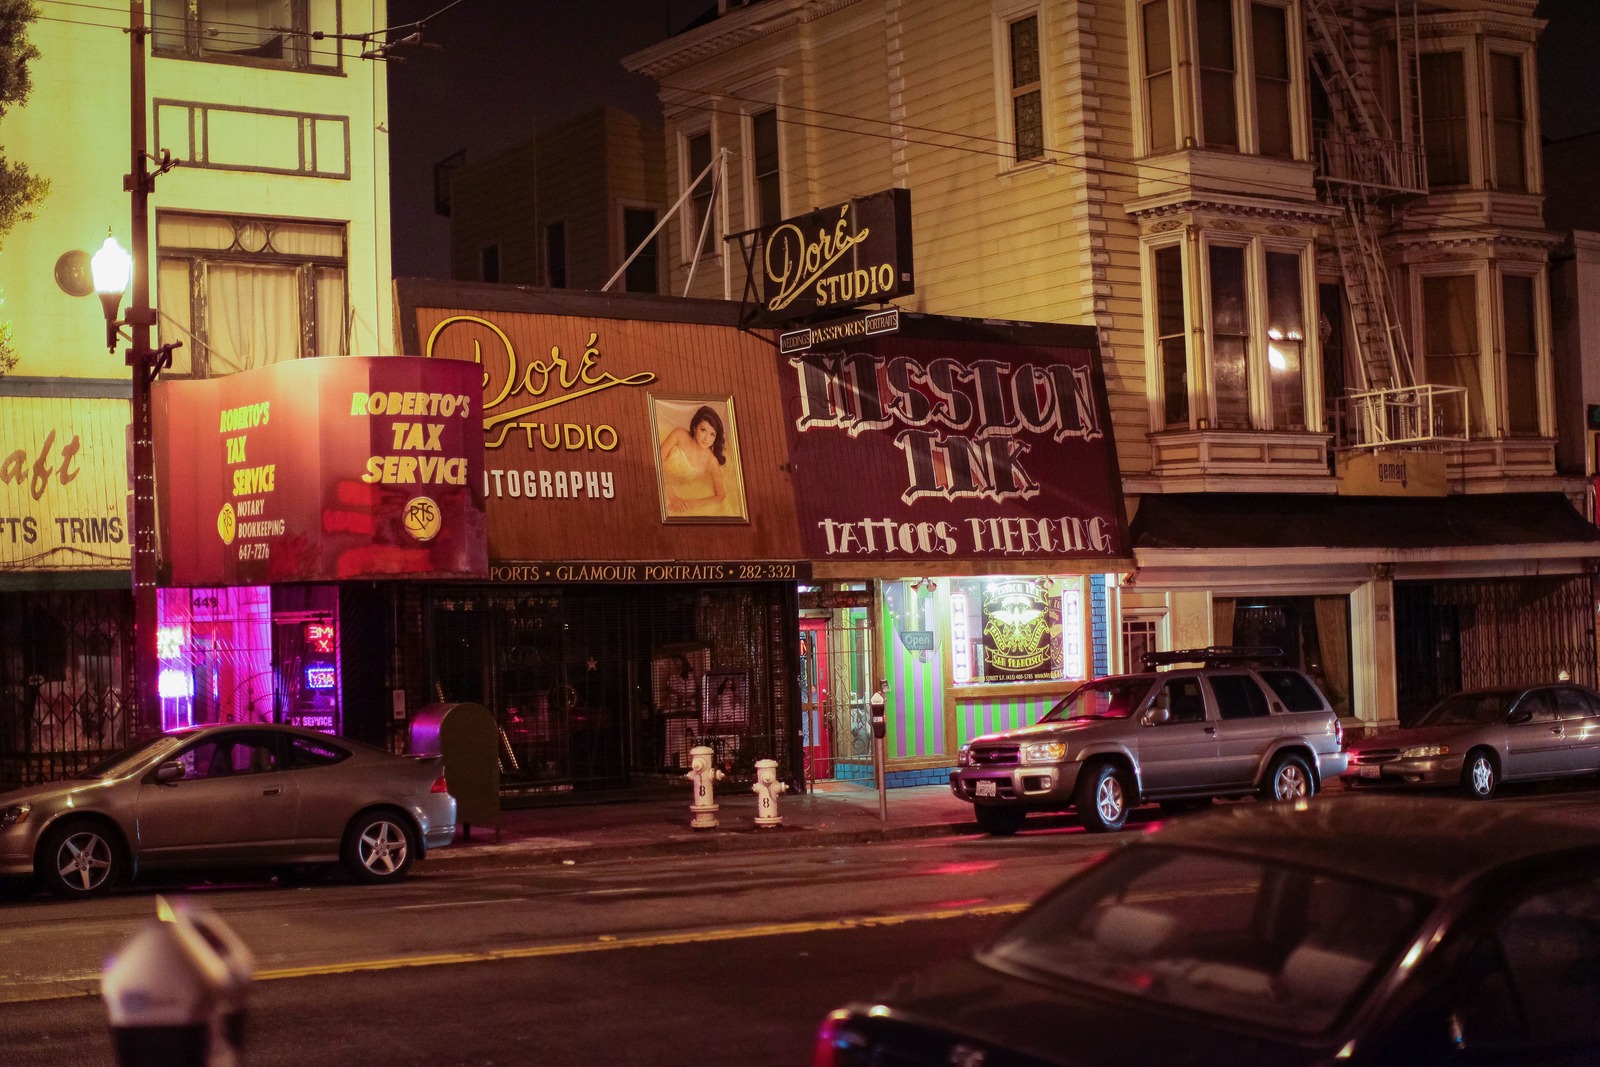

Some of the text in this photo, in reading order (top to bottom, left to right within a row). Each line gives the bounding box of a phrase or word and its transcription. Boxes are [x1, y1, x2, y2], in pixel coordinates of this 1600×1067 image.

[765, 205, 869, 311] Doré
[816, 264, 894, 306] STUDIO
[812, 320, 864, 344] PASSPORTS
[867, 314, 897, 330] PORTRAITS
[351, 392, 470, 418] ROBERTO'S
[787, 350, 1103, 442] MISSION
[220, 401, 270, 433] ROBERTO'S
[226, 436, 247, 464] TAX
[392, 423, 445, 451] TAX
[233, 464, 275, 496] SERVICE
[362, 456, 468, 485] SERVICE
[894, 429, 1039, 505] INK
[1378, 459, 1407, 482] gemart
[237, 499, 265, 517] NOTARY
[411, 503, 434, 529] RTS
[55, 516, 124, 544] TRIMS
[238, 519, 285, 539] BOOKKEEPING
[818, 515, 1114, 555] TATTOOS PIERCING
[239, 543, 270, 560] 647-7276
[557, 565, 636, 580] GLAMOUR
[645, 564, 724, 580] PORTRAITS
[739, 564, 796, 579] 282-3321
[905, 635, 930, 646] Open
[302, 716, 333, 727] SERVICE
